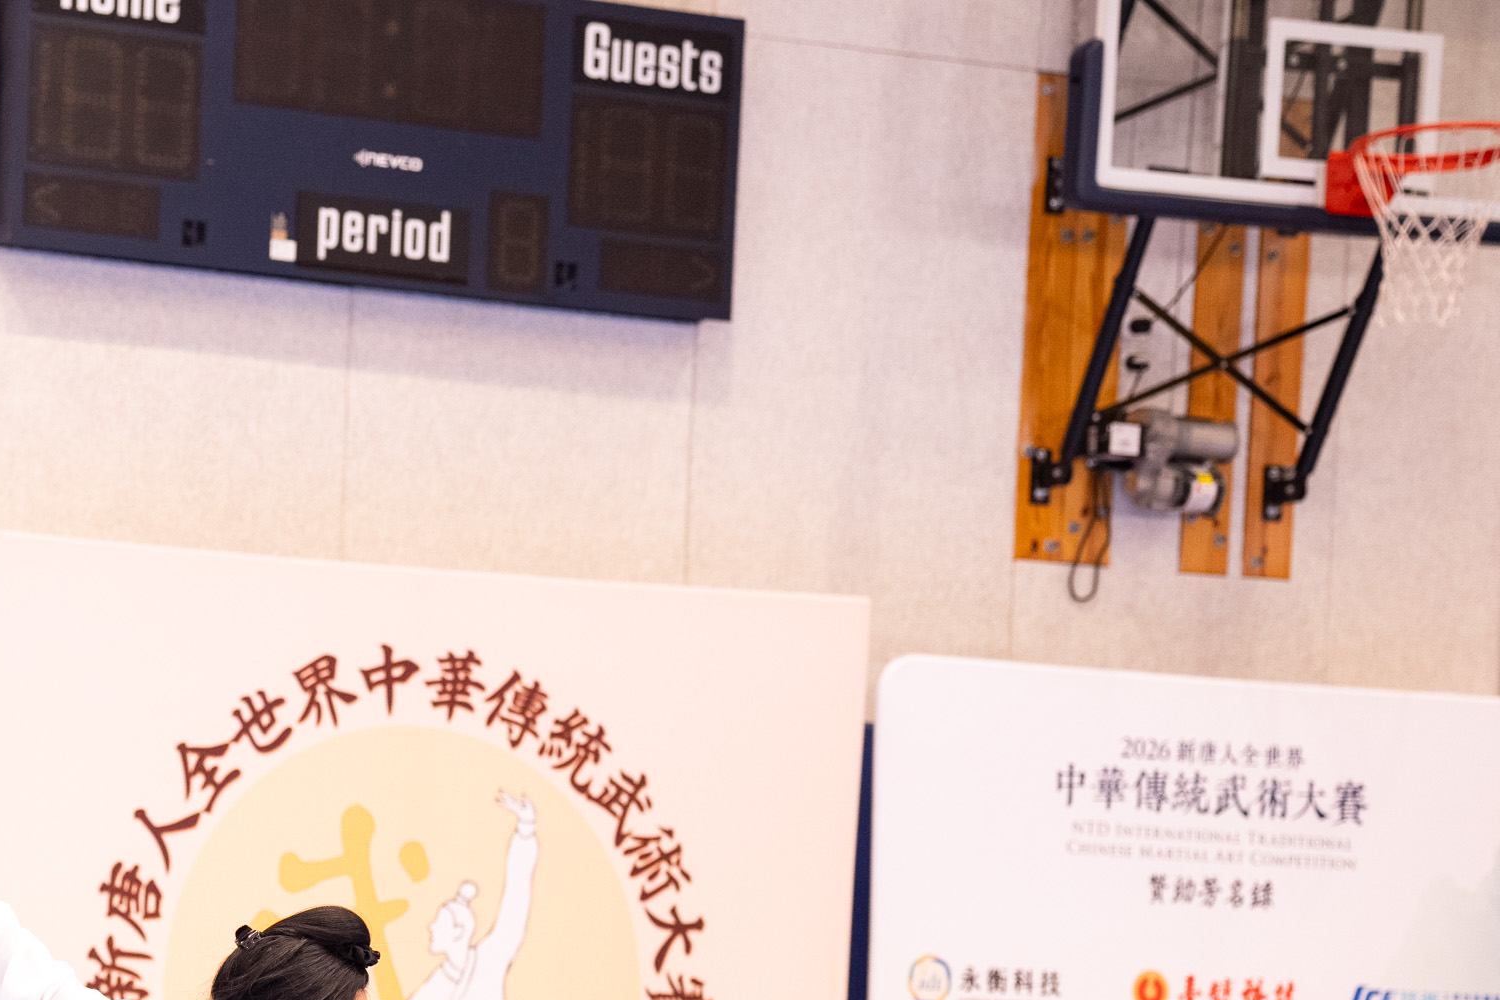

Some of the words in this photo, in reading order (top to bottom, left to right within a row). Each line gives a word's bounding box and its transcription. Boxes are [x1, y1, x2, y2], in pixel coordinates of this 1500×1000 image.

[583, 21, 723, 94] Guests
[316, 206, 452, 264] period
[1120, 736, 1171, 761] 2026
[1056, 763, 1367, 826] 中華傳統武術大賽
